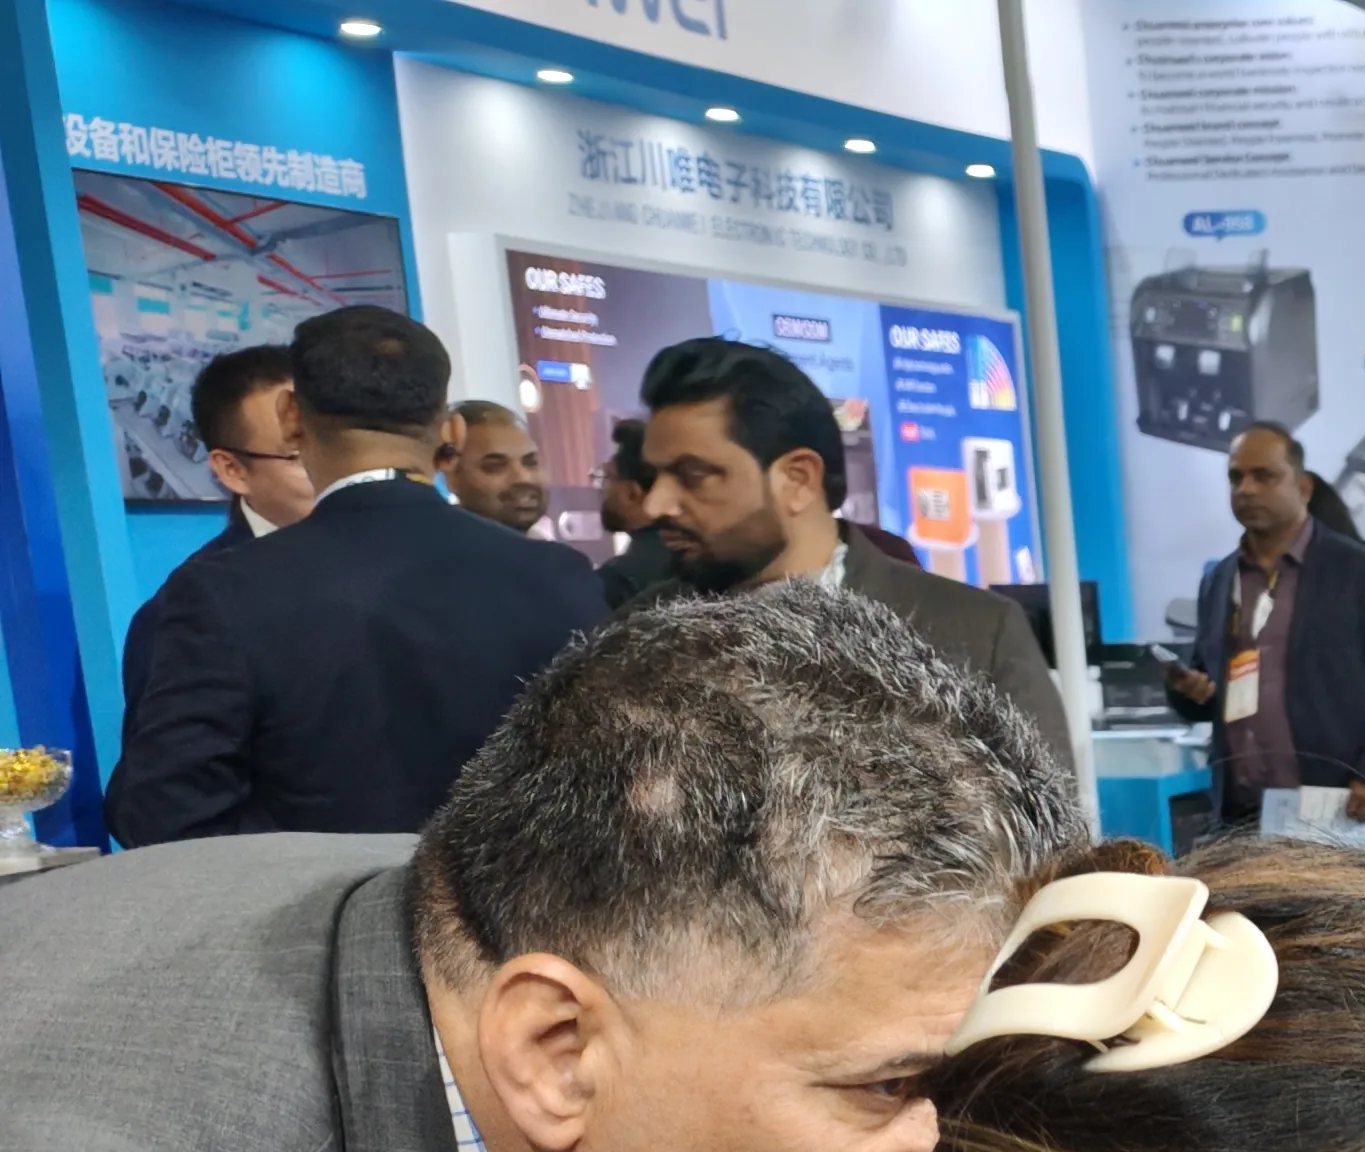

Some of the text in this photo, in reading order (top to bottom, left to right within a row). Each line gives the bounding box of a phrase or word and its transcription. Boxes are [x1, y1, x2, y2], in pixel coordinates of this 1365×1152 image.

[525, 266, 607, 300] OUR SAFES
[889, 324, 961, 354] OUR SAFES
